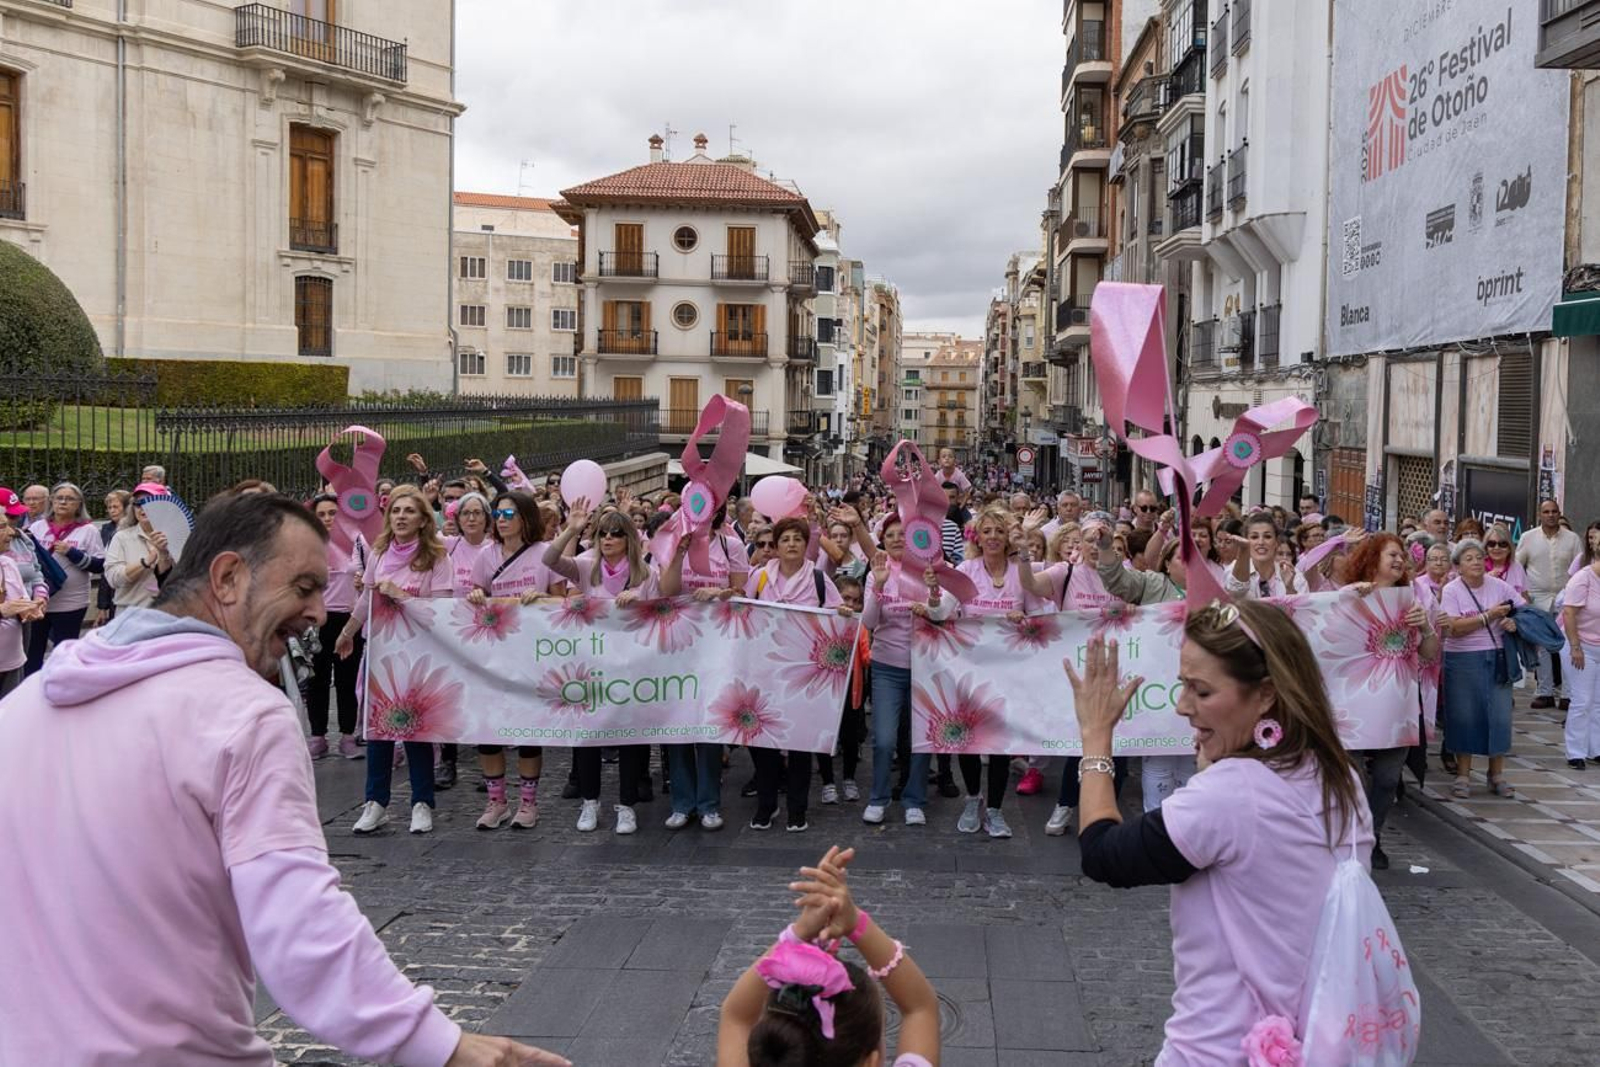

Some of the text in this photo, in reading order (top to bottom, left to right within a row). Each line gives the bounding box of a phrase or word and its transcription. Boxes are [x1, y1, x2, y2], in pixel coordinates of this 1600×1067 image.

[1438, 7, 1513, 88] Festival
[1408, 73, 1489, 141] de Otoño
[1446, 127, 1458, 143] de
[1340, 302, 1370, 327] Blanca
[536, 632, 605, 662] por tí
[1127, 636, 1141, 660] tí
[561, 670, 698, 714] ajicam
[575, 725, 637, 742] jiennense
